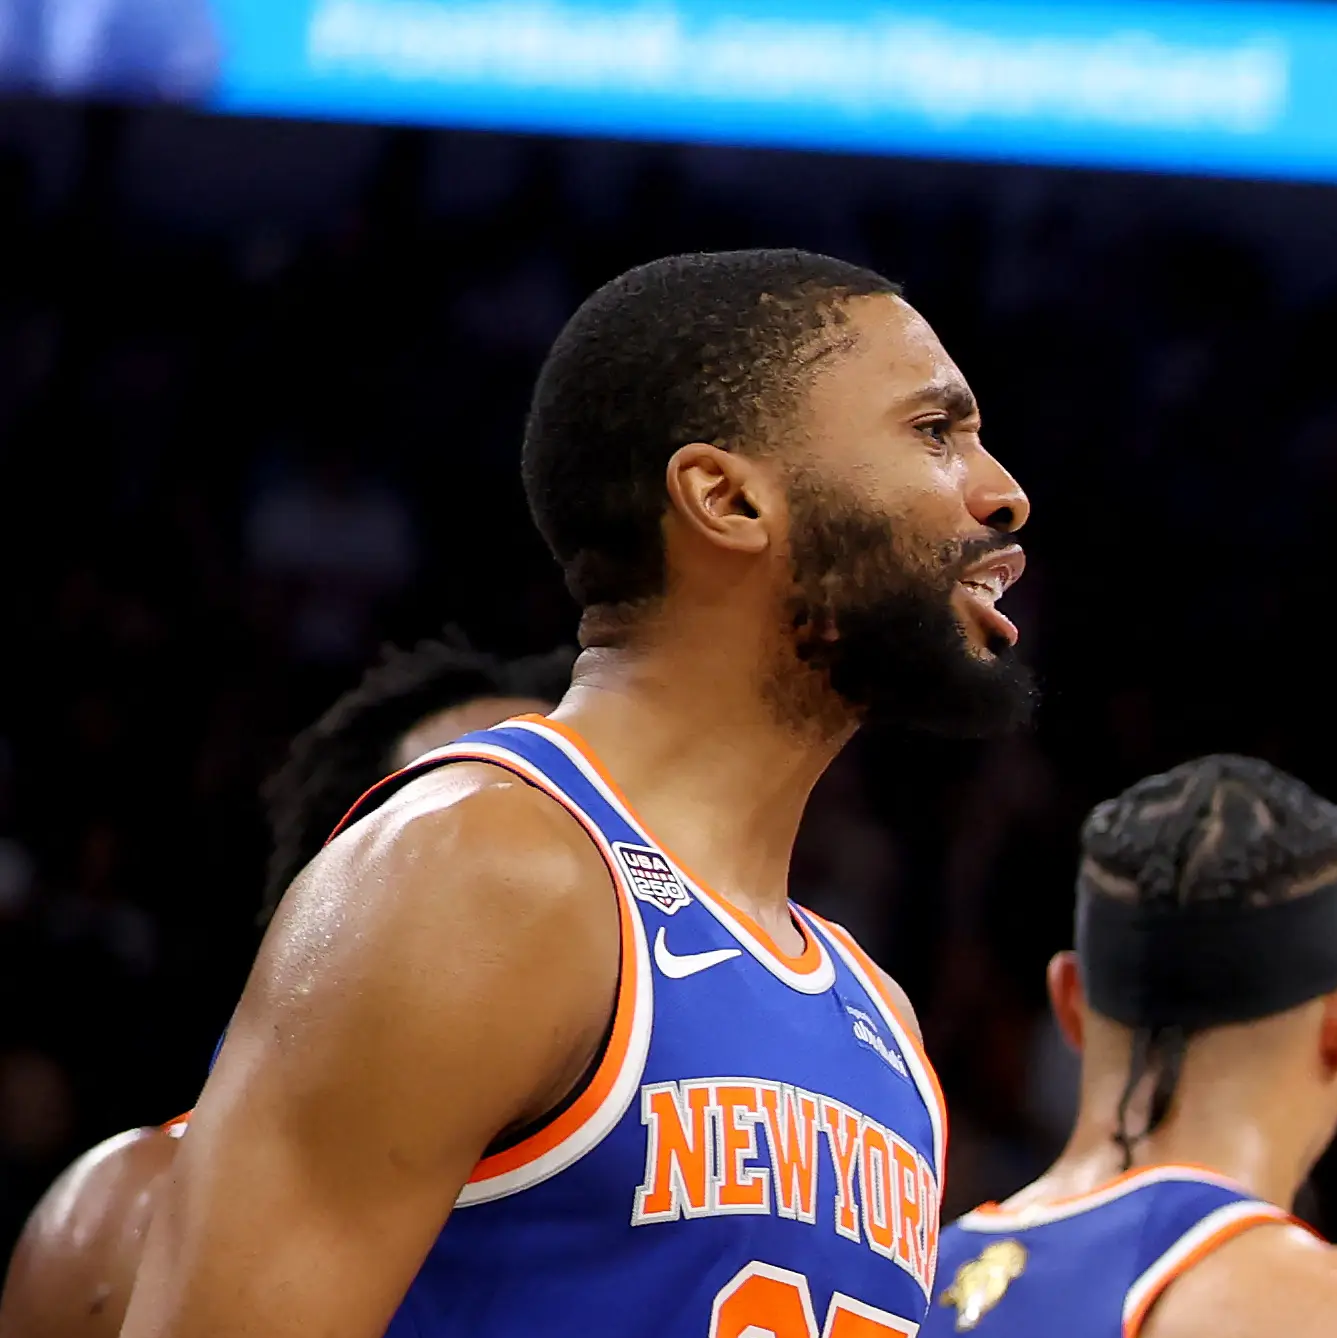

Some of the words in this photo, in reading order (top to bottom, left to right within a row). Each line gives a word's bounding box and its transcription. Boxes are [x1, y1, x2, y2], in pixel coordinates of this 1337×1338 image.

[622, 851, 669, 872] USA
[634, 877, 685, 899] 250
[630, 1076, 821, 1227] NEW
[818, 1094, 940, 1305] YORK
